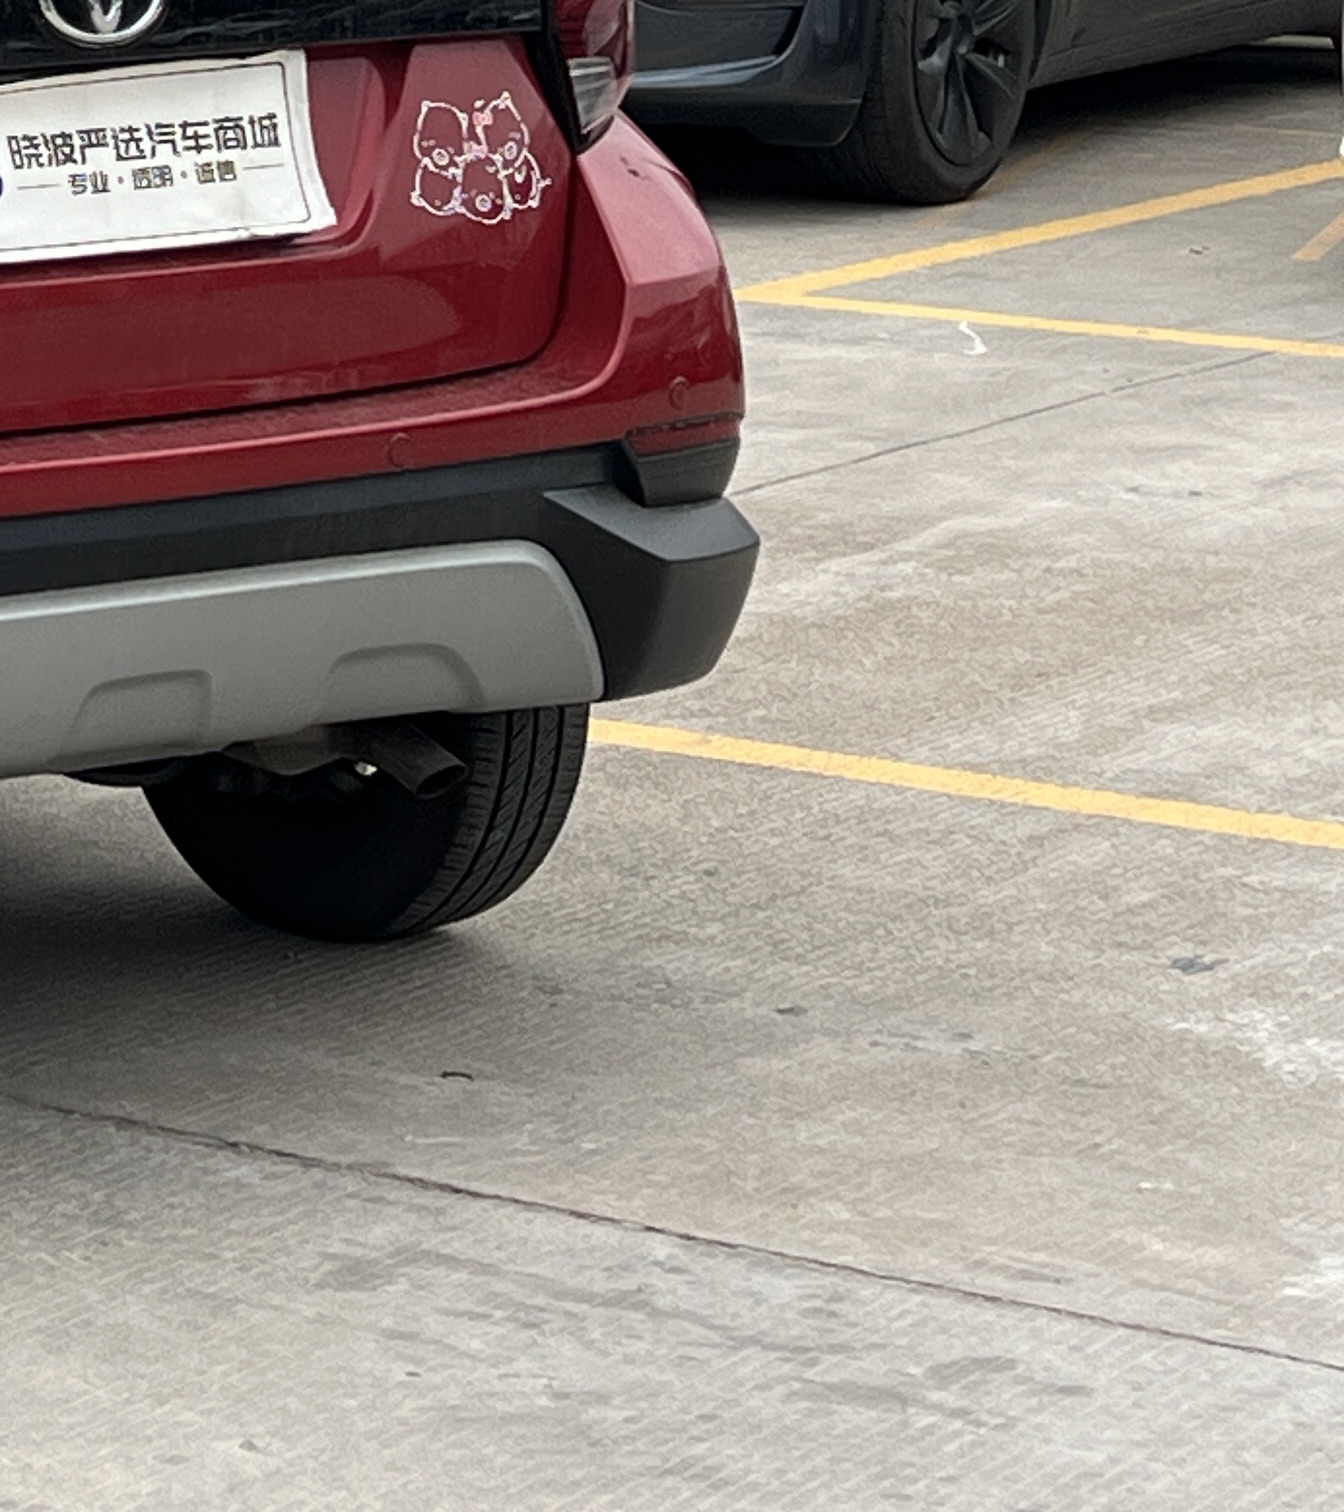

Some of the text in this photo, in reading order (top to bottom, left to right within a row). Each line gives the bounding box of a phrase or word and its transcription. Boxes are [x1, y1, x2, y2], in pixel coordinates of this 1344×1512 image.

[7, 112, 282, 170] 晓波严选汽车商城
